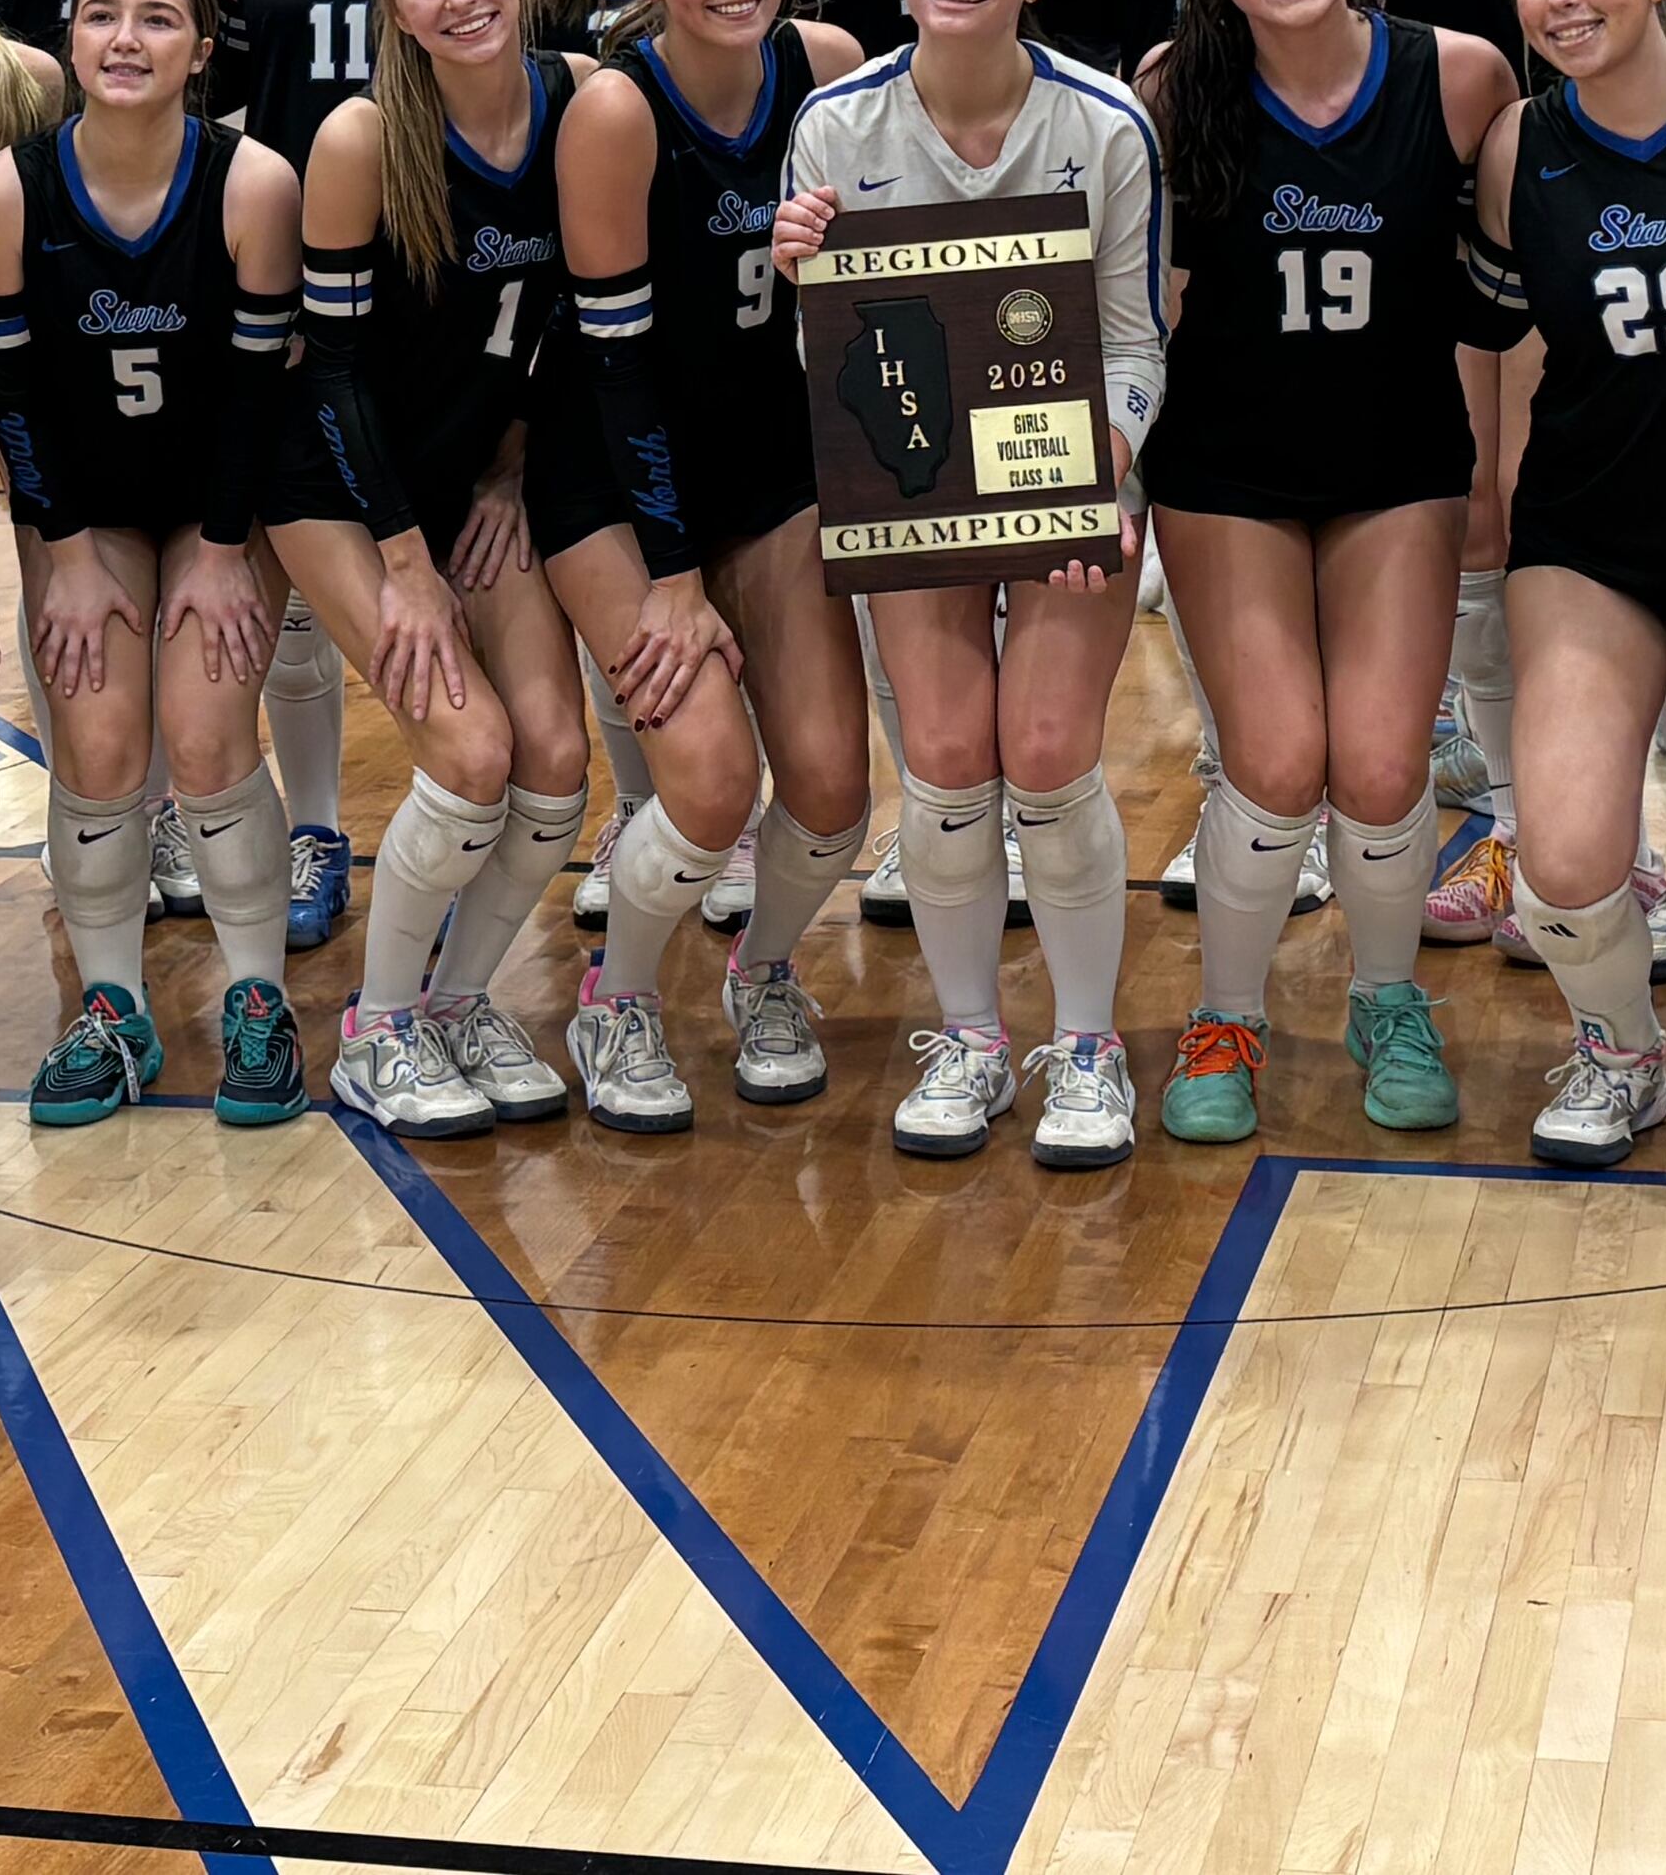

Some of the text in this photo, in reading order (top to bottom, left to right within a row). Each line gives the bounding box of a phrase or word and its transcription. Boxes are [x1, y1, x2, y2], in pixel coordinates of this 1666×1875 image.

[309, 3, 371, 80] 11
[1263, 184, 1383, 234] Stars
[832, 236, 1059, 277] REGIONAL
[78, 289, 187, 334] Stars
[737, 246, 776, 329] 9
[1276, 247, 1373, 334] 19
[484, 279, 525, 358] 1
[110, 347, 164, 417] 5
[987, 359, 1067, 391] 2026
[1014, 412, 1049, 435] GIRLS
[997, 436, 1071, 462] VOLLEYBALL
[627, 424, 687, 533] North
[1009, 466, 1064, 488] CLASS 4A
[836, 507, 1100, 553] CHAMPIONS
